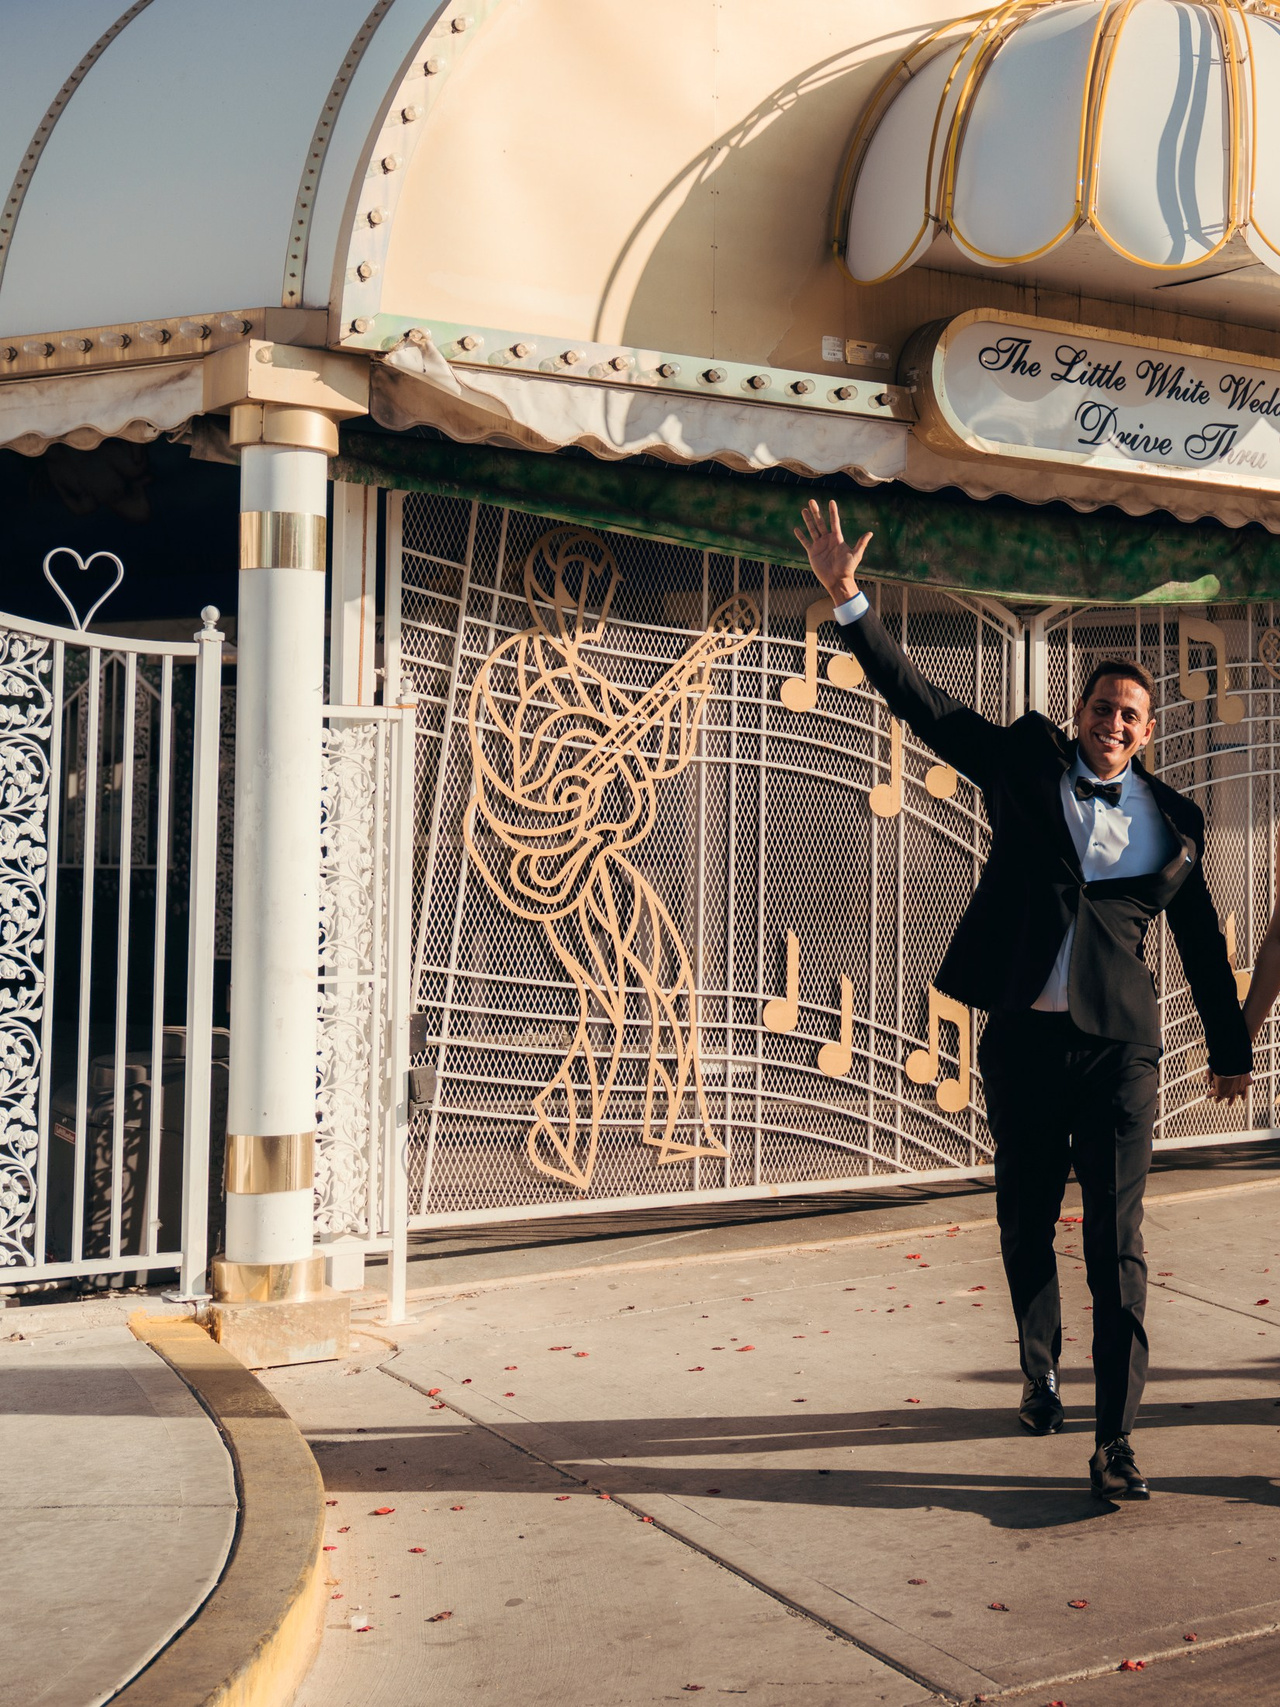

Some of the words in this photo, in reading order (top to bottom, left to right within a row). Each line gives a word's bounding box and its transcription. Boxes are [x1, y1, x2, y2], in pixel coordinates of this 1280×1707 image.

[978, 337, 1042, 377] The
[1050, 345, 1126, 391] Little
[1136, 360, 1210, 404] White
[1075, 401, 1172, 455] Drive
[1185, 423, 1267, 469] Thru
